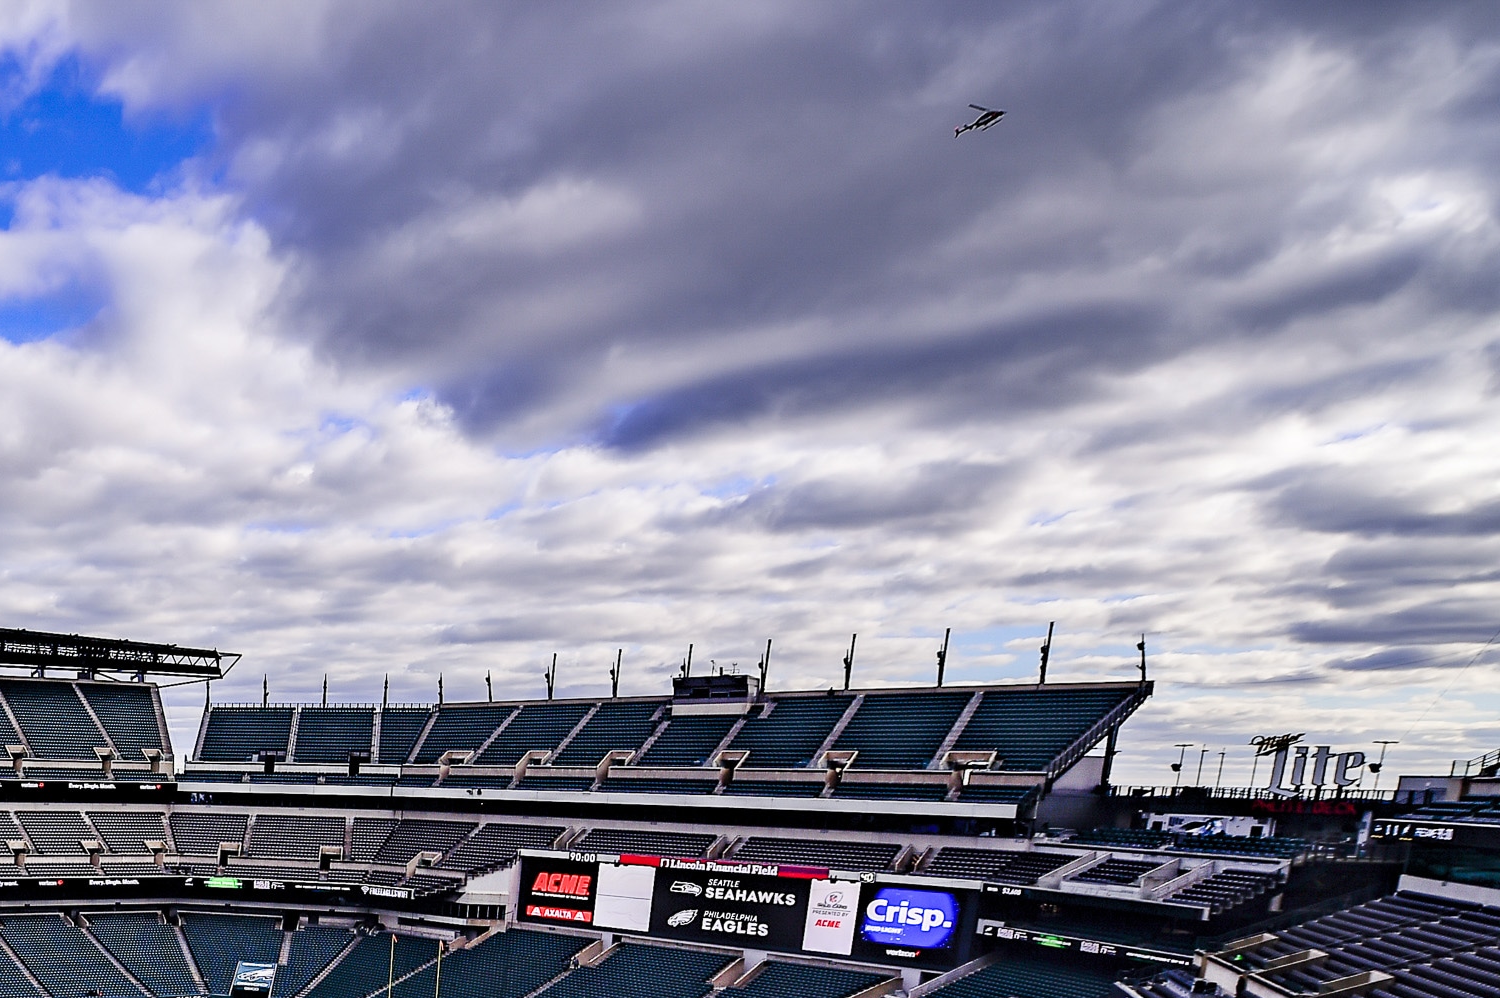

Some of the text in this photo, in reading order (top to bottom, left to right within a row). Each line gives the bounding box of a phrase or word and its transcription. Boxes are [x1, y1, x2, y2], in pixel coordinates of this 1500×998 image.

[1267, 746, 1366, 798] Lite
[570, 852, 596, 862] 90:00
[670, 859, 778, 876] Lincoln Financial Field
[708, 879, 740, 888] SEATTLE
[705, 886, 796, 906] SEAHAWKS
[544, 908, 572, 920] AXALTA
[703, 910, 758, 922] PHILADELPHIA
[866, 899, 952, 932] Crisp.
[701, 918, 769, 936] EAGLES
[815, 919, 841, 929] ACME
